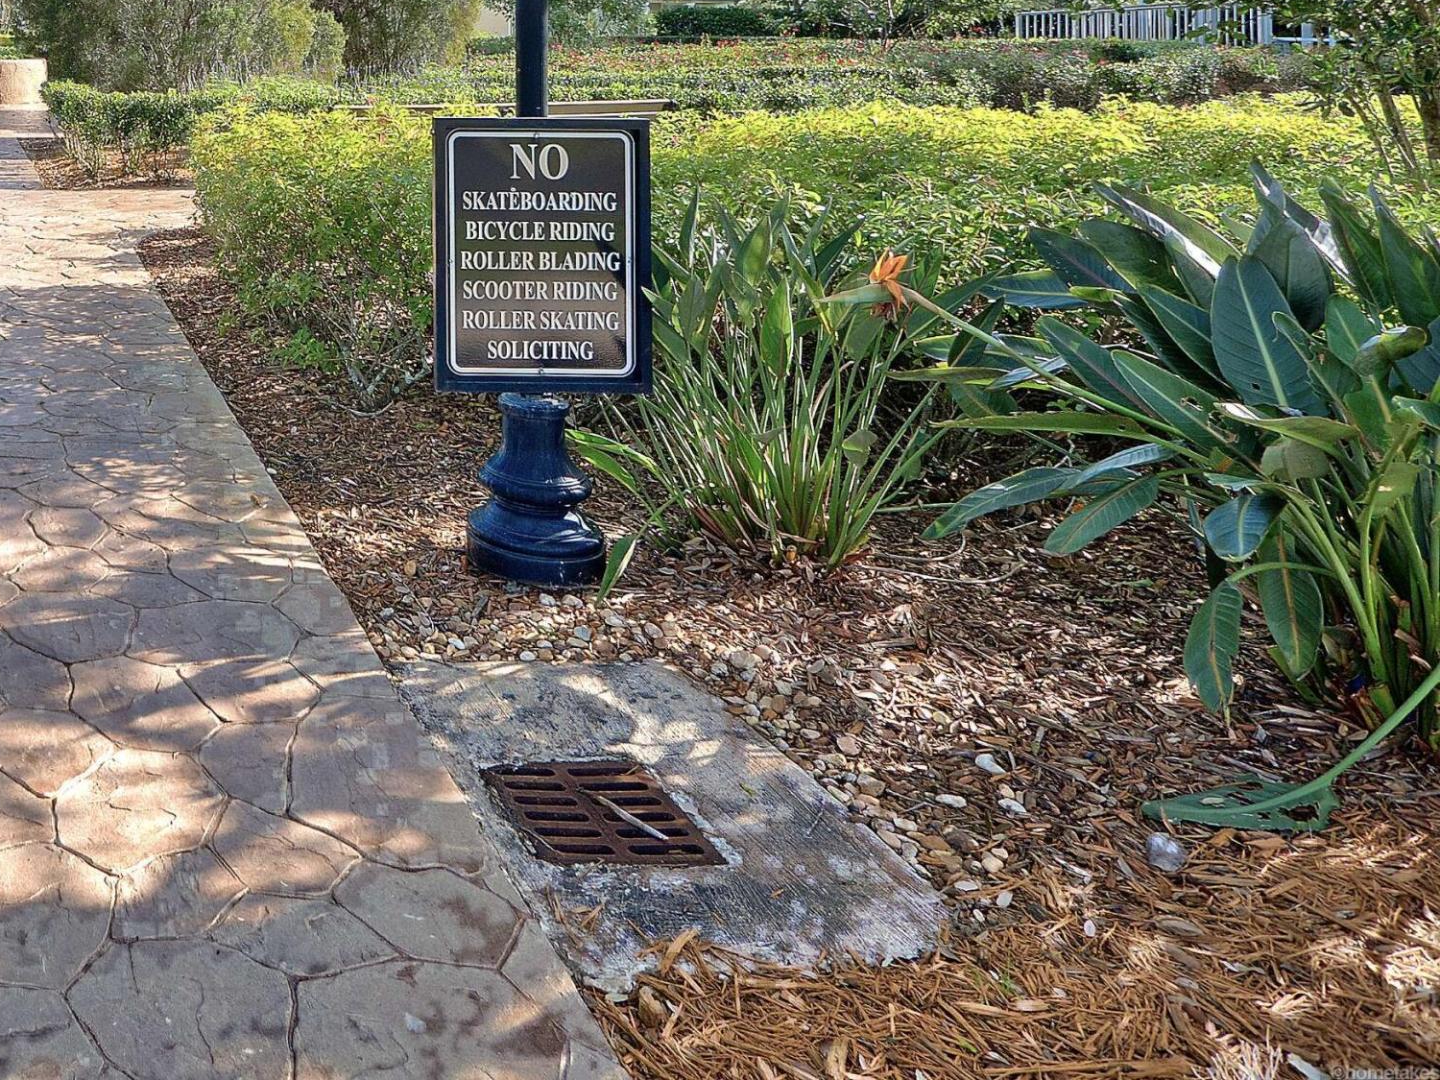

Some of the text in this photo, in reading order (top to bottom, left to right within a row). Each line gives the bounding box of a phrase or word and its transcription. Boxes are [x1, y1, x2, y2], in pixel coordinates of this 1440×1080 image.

[510, 144, 569, 180] NO
[463, 191, 617, 211] SKATEBOARDING
[466, 222, 615, 241] BICYCLE RIDING
[461, 252, 621, 271] ROLLER BLADING
[463, 281, 618, 301] SCOOTER RIDING
[462, 310, 619, 330] ROLLER SKATING
[488, 341, 593, 360] SOLICITING
